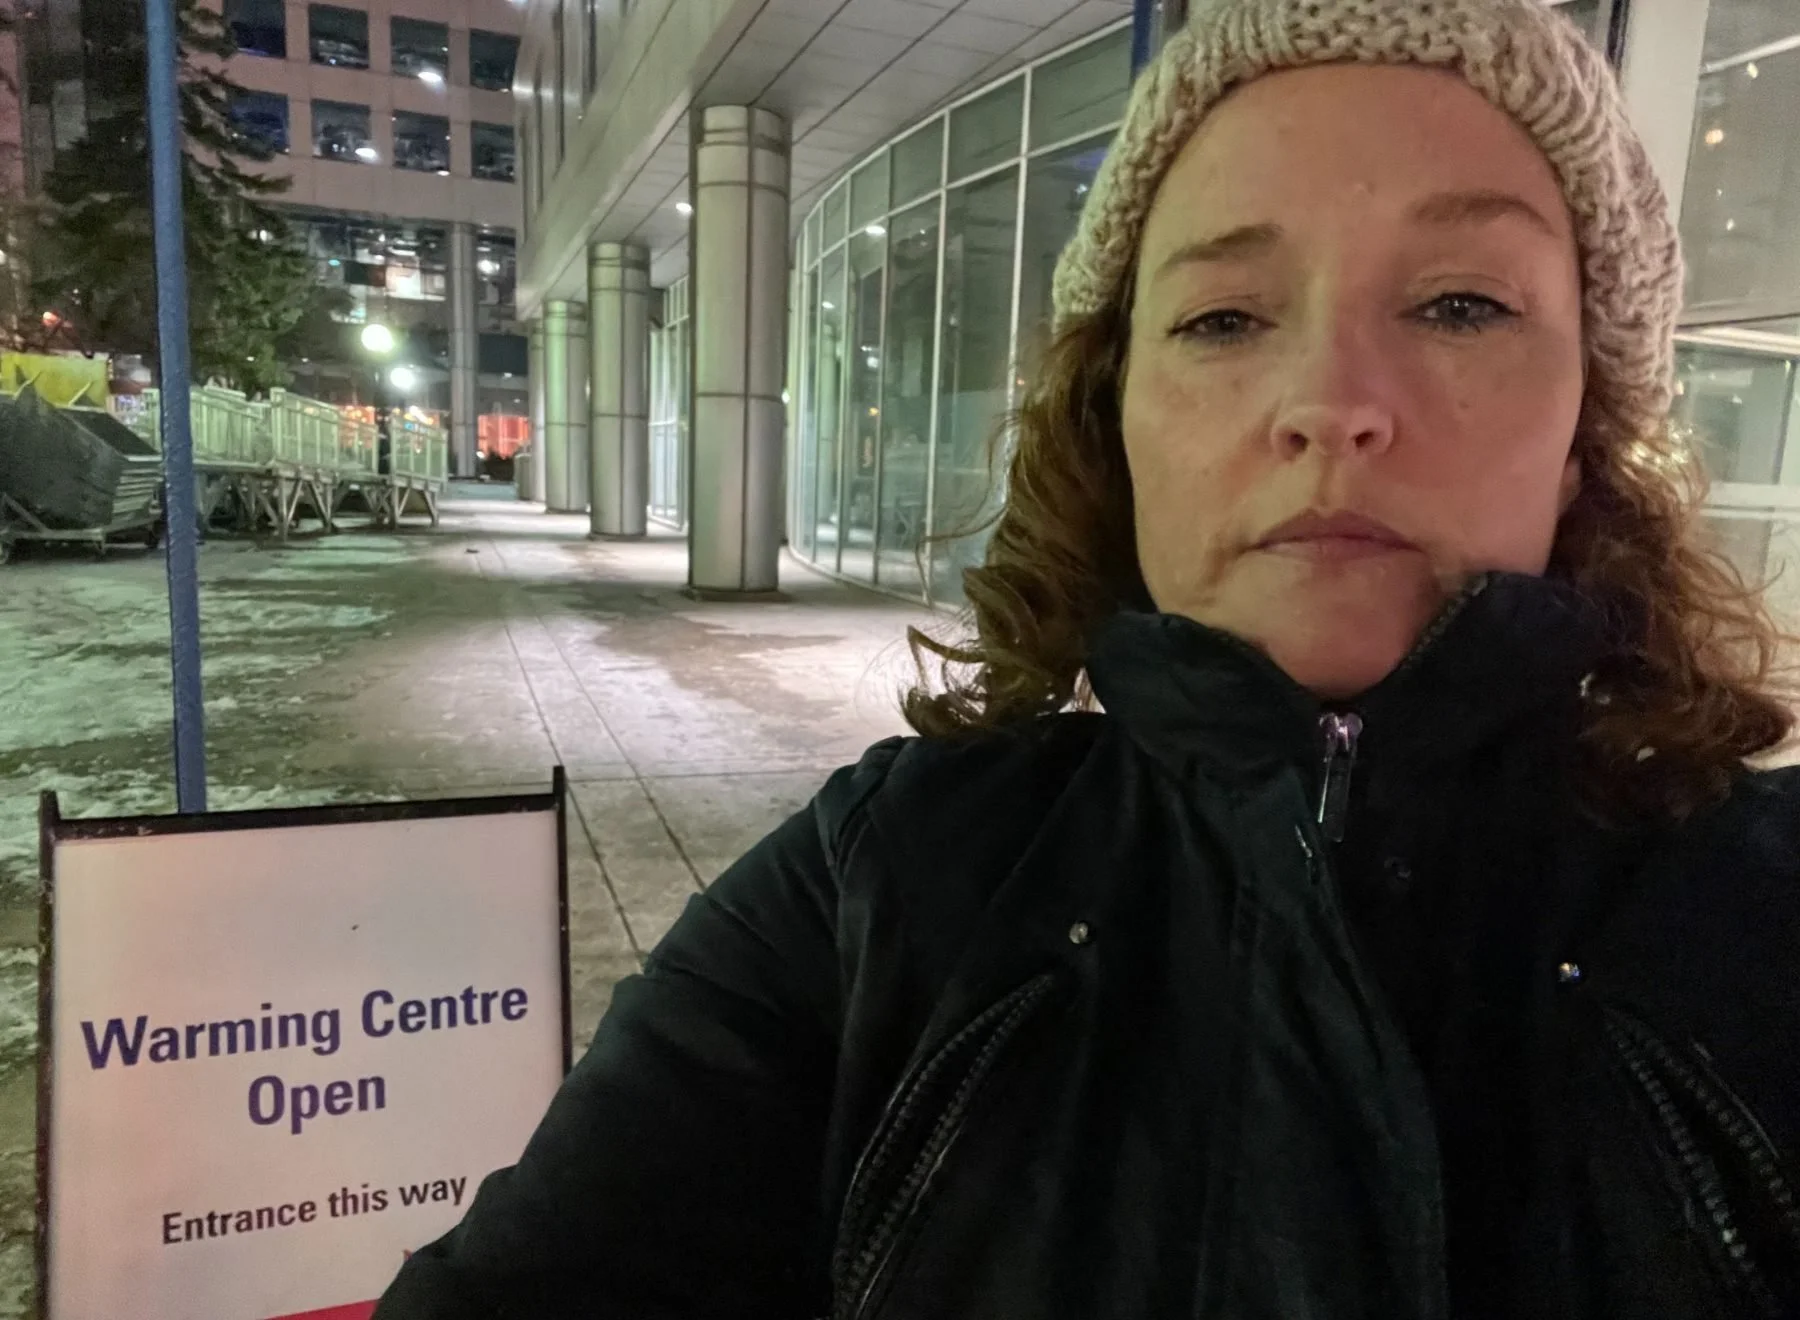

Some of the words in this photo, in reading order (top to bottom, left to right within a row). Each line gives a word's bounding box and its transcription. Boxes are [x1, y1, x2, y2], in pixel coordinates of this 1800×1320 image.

[81, 1002, 341, 1070] Warming
[361, 986, 528, 1038] Centre
[248, 1075, 386, 1135] Open
[162, 1201, 317, 1245] Entrance
[328, 1183, 389, 1218] this
[399, 1177, 467, 1207] way
